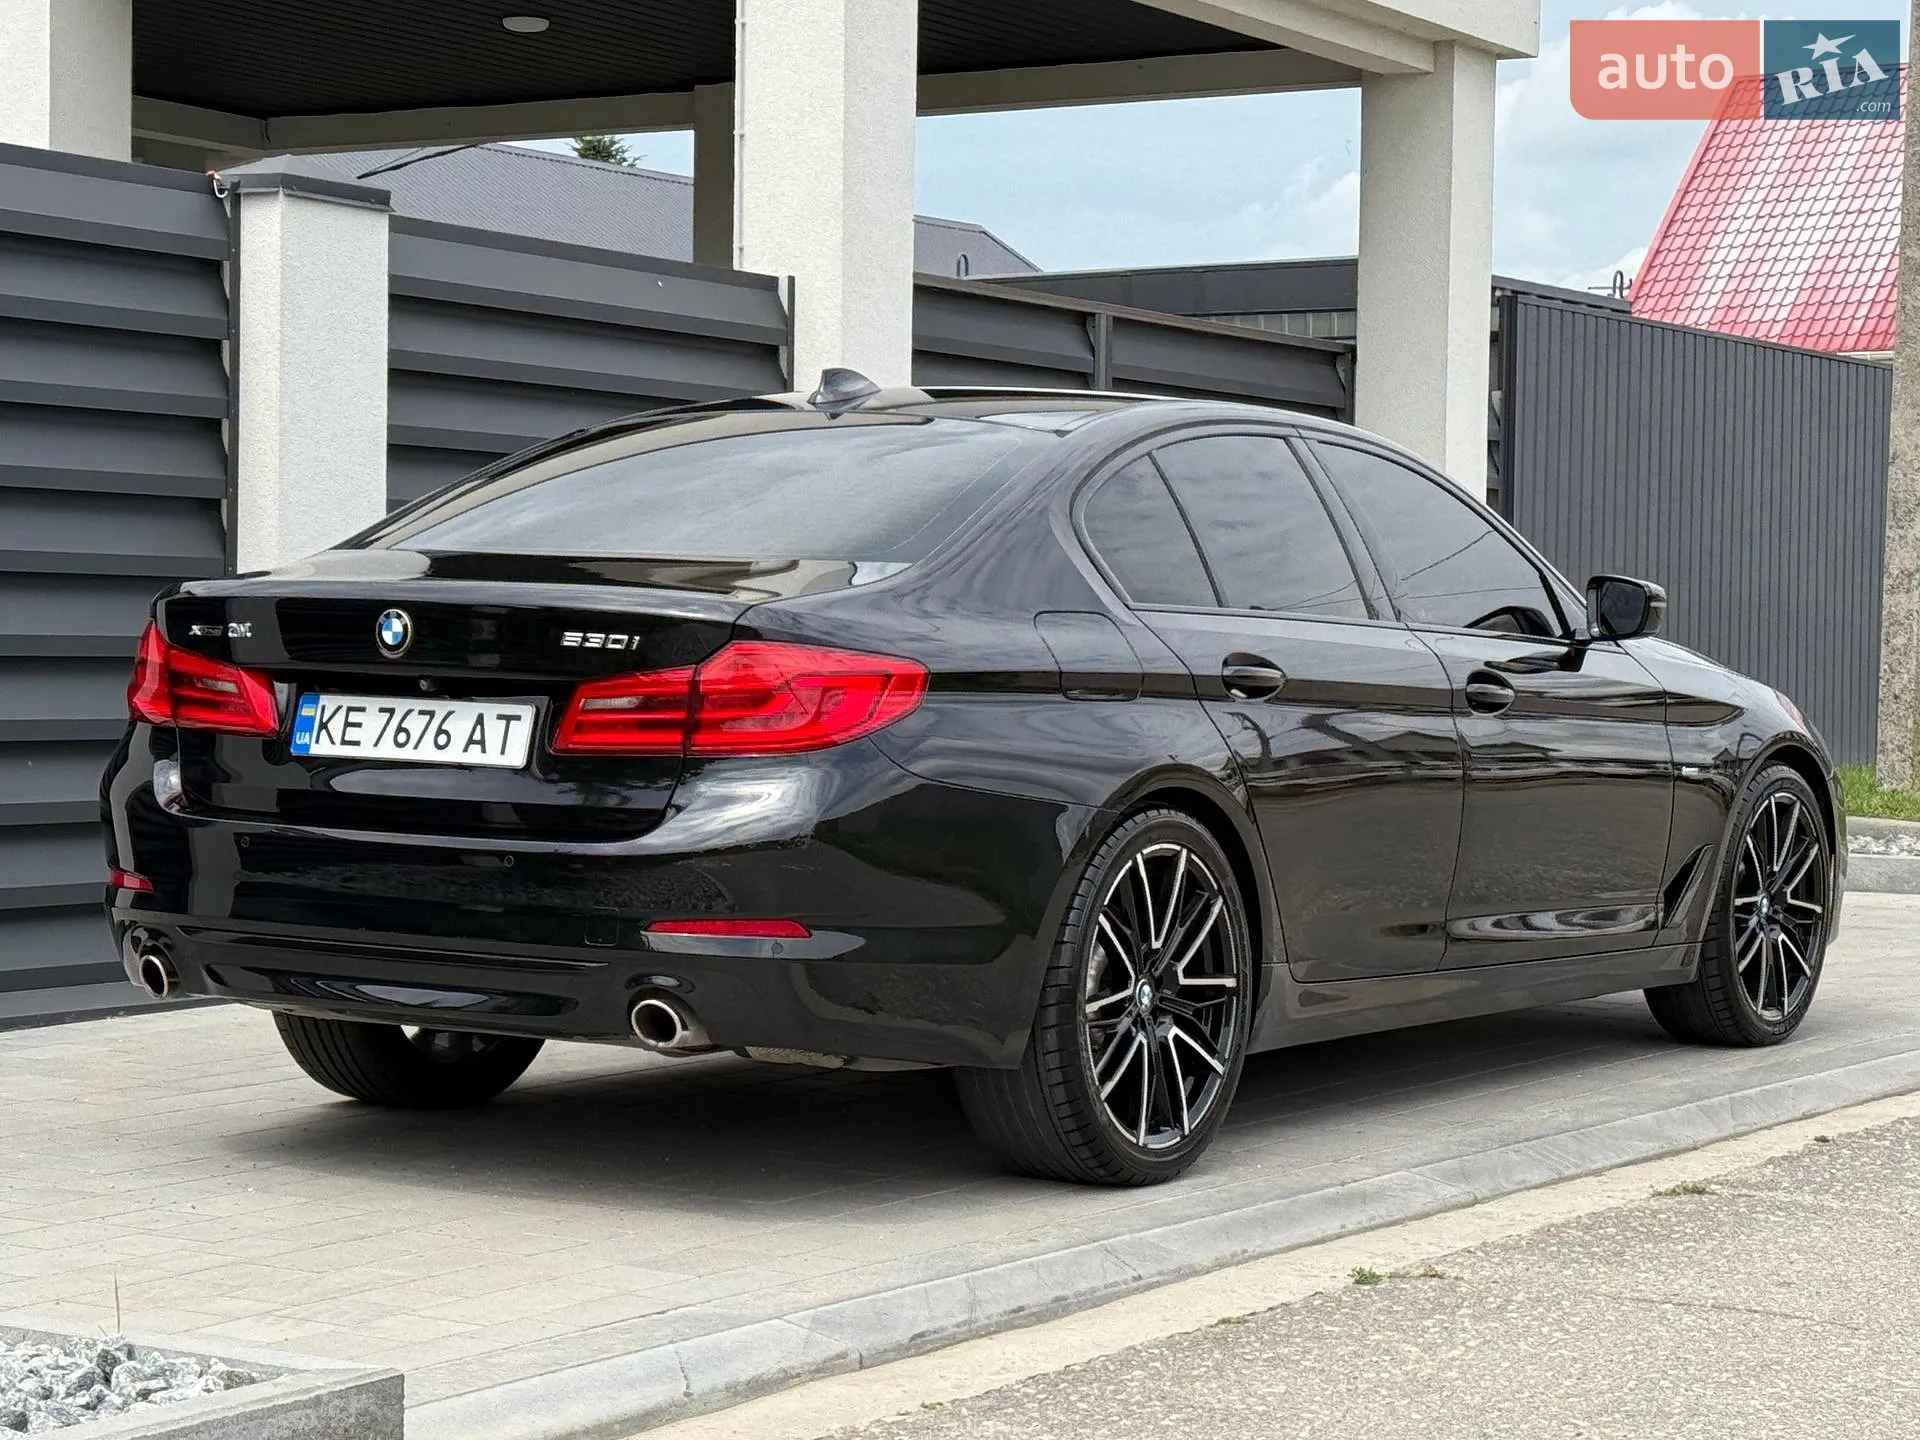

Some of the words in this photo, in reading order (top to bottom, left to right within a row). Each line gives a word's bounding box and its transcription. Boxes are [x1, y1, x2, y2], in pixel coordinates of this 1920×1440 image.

[560, 631, 640, 651] 530i
[296, 732, 310, 745] UA
[315, 704, 367, 747] KE
[373, 707, 455, 751] 7676
[462, 712, 522, 756] AT
